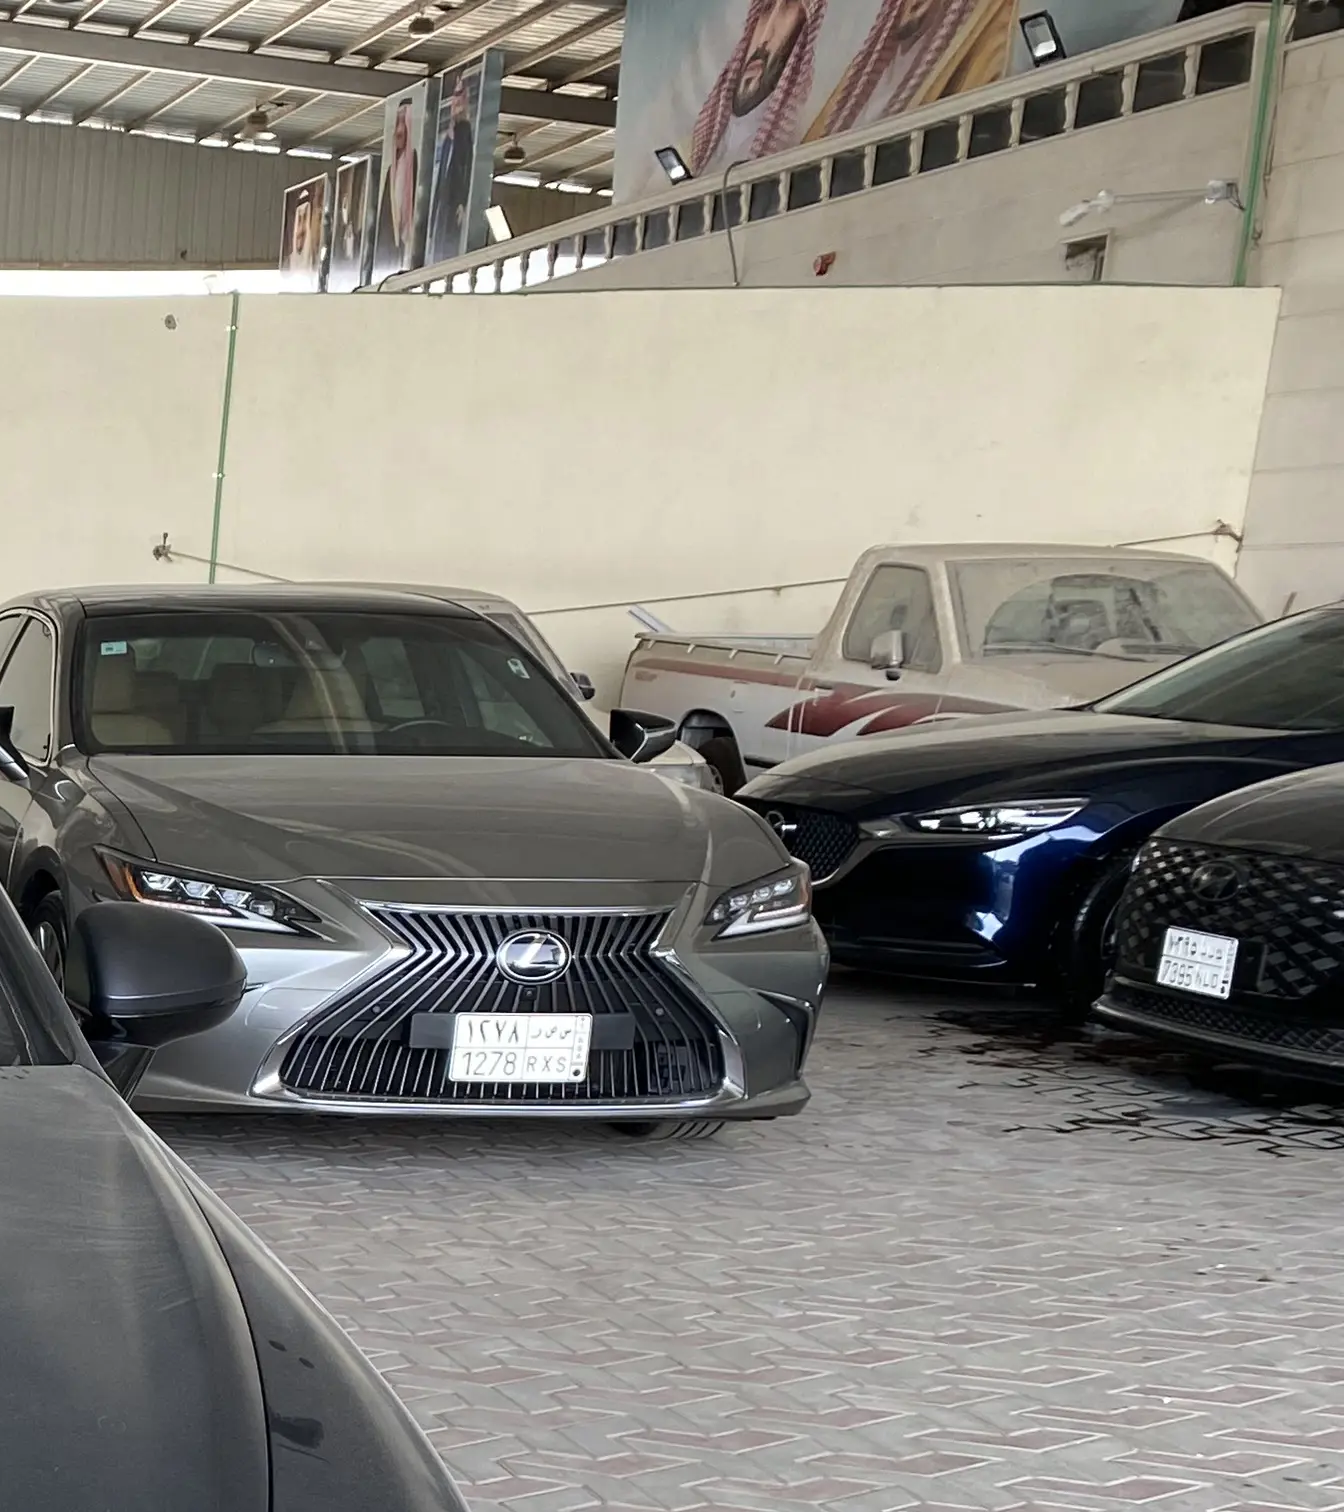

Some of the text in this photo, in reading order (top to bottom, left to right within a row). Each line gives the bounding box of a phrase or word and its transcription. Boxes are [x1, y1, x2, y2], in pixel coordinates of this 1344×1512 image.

[1160, 959, 1193, 986] 7395
[467, 1019, 519, 1043] ١٢٧٨
[462, 1051, 518, 1076] 1278
